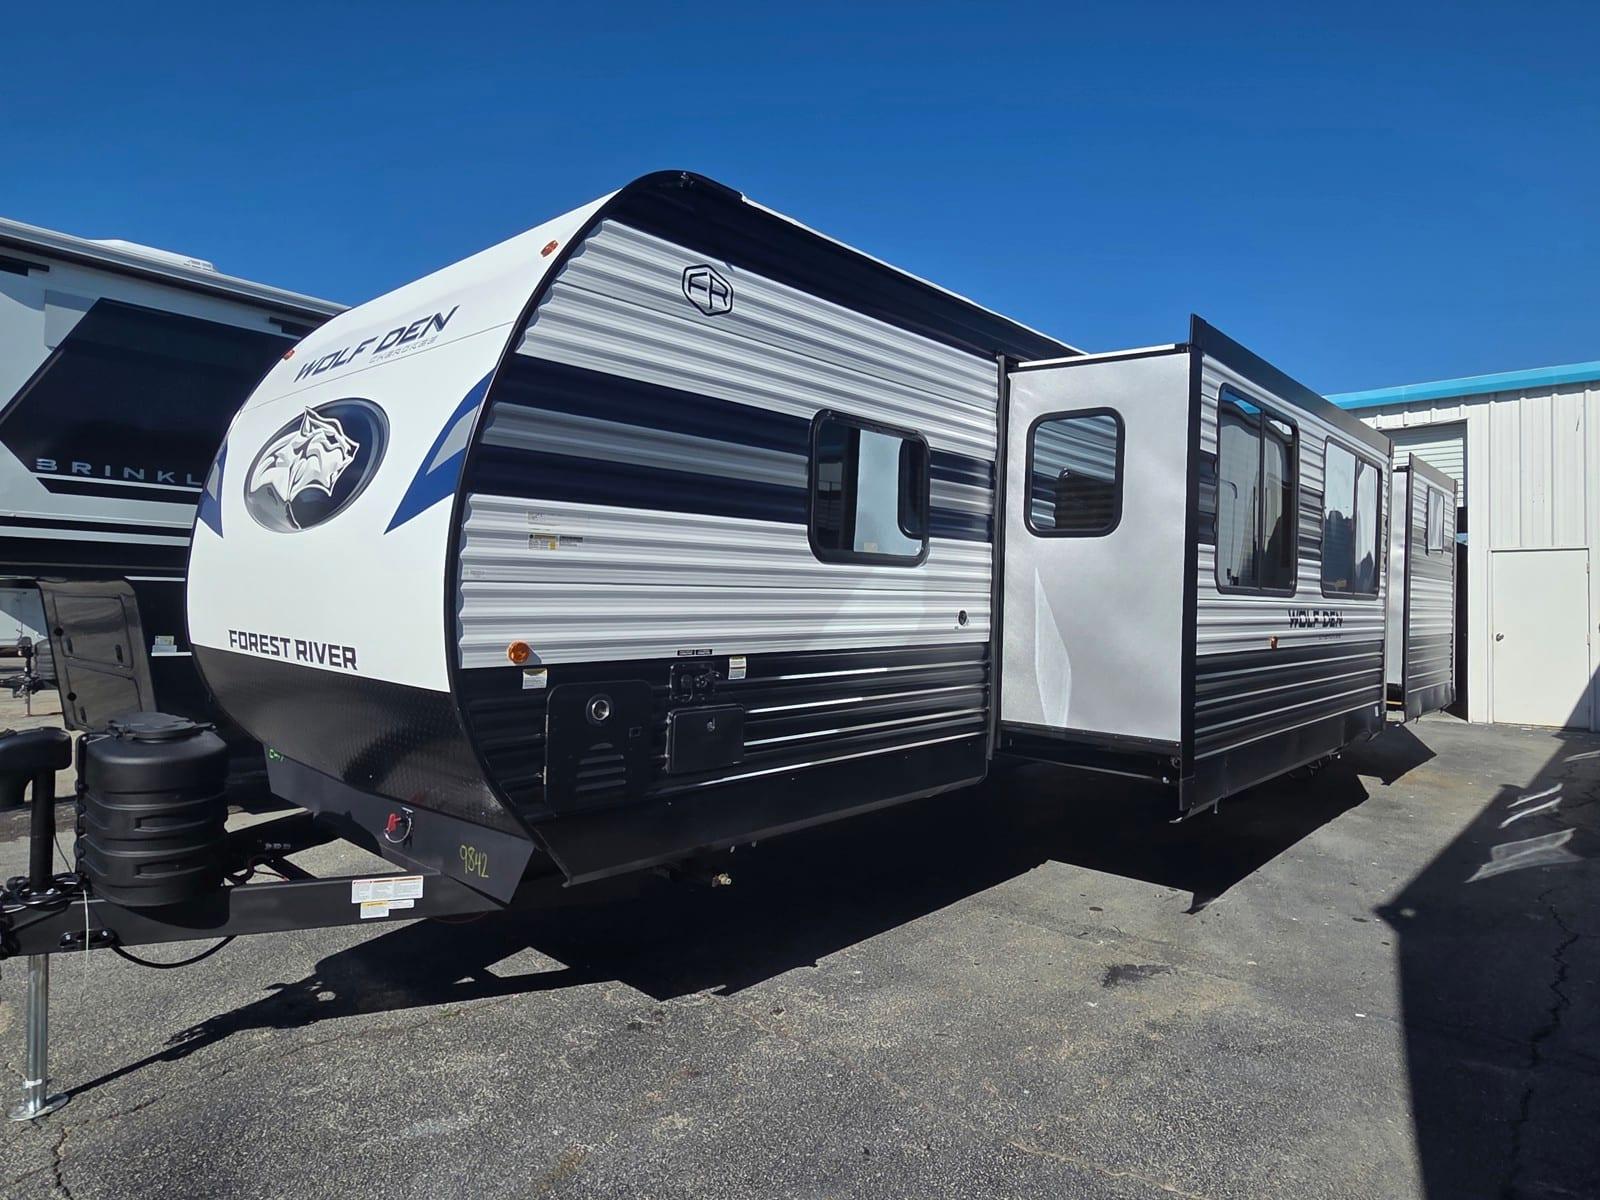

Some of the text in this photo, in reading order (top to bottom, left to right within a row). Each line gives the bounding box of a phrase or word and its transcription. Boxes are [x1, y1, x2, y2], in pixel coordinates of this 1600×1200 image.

[294, 304, 460, 383] WOLF DEN
[1287, 608, 1344, 629] WOLF DEN
[228, 629, 358, 670] FOREST RIVER
[460, 844, 489, 878] 9842
